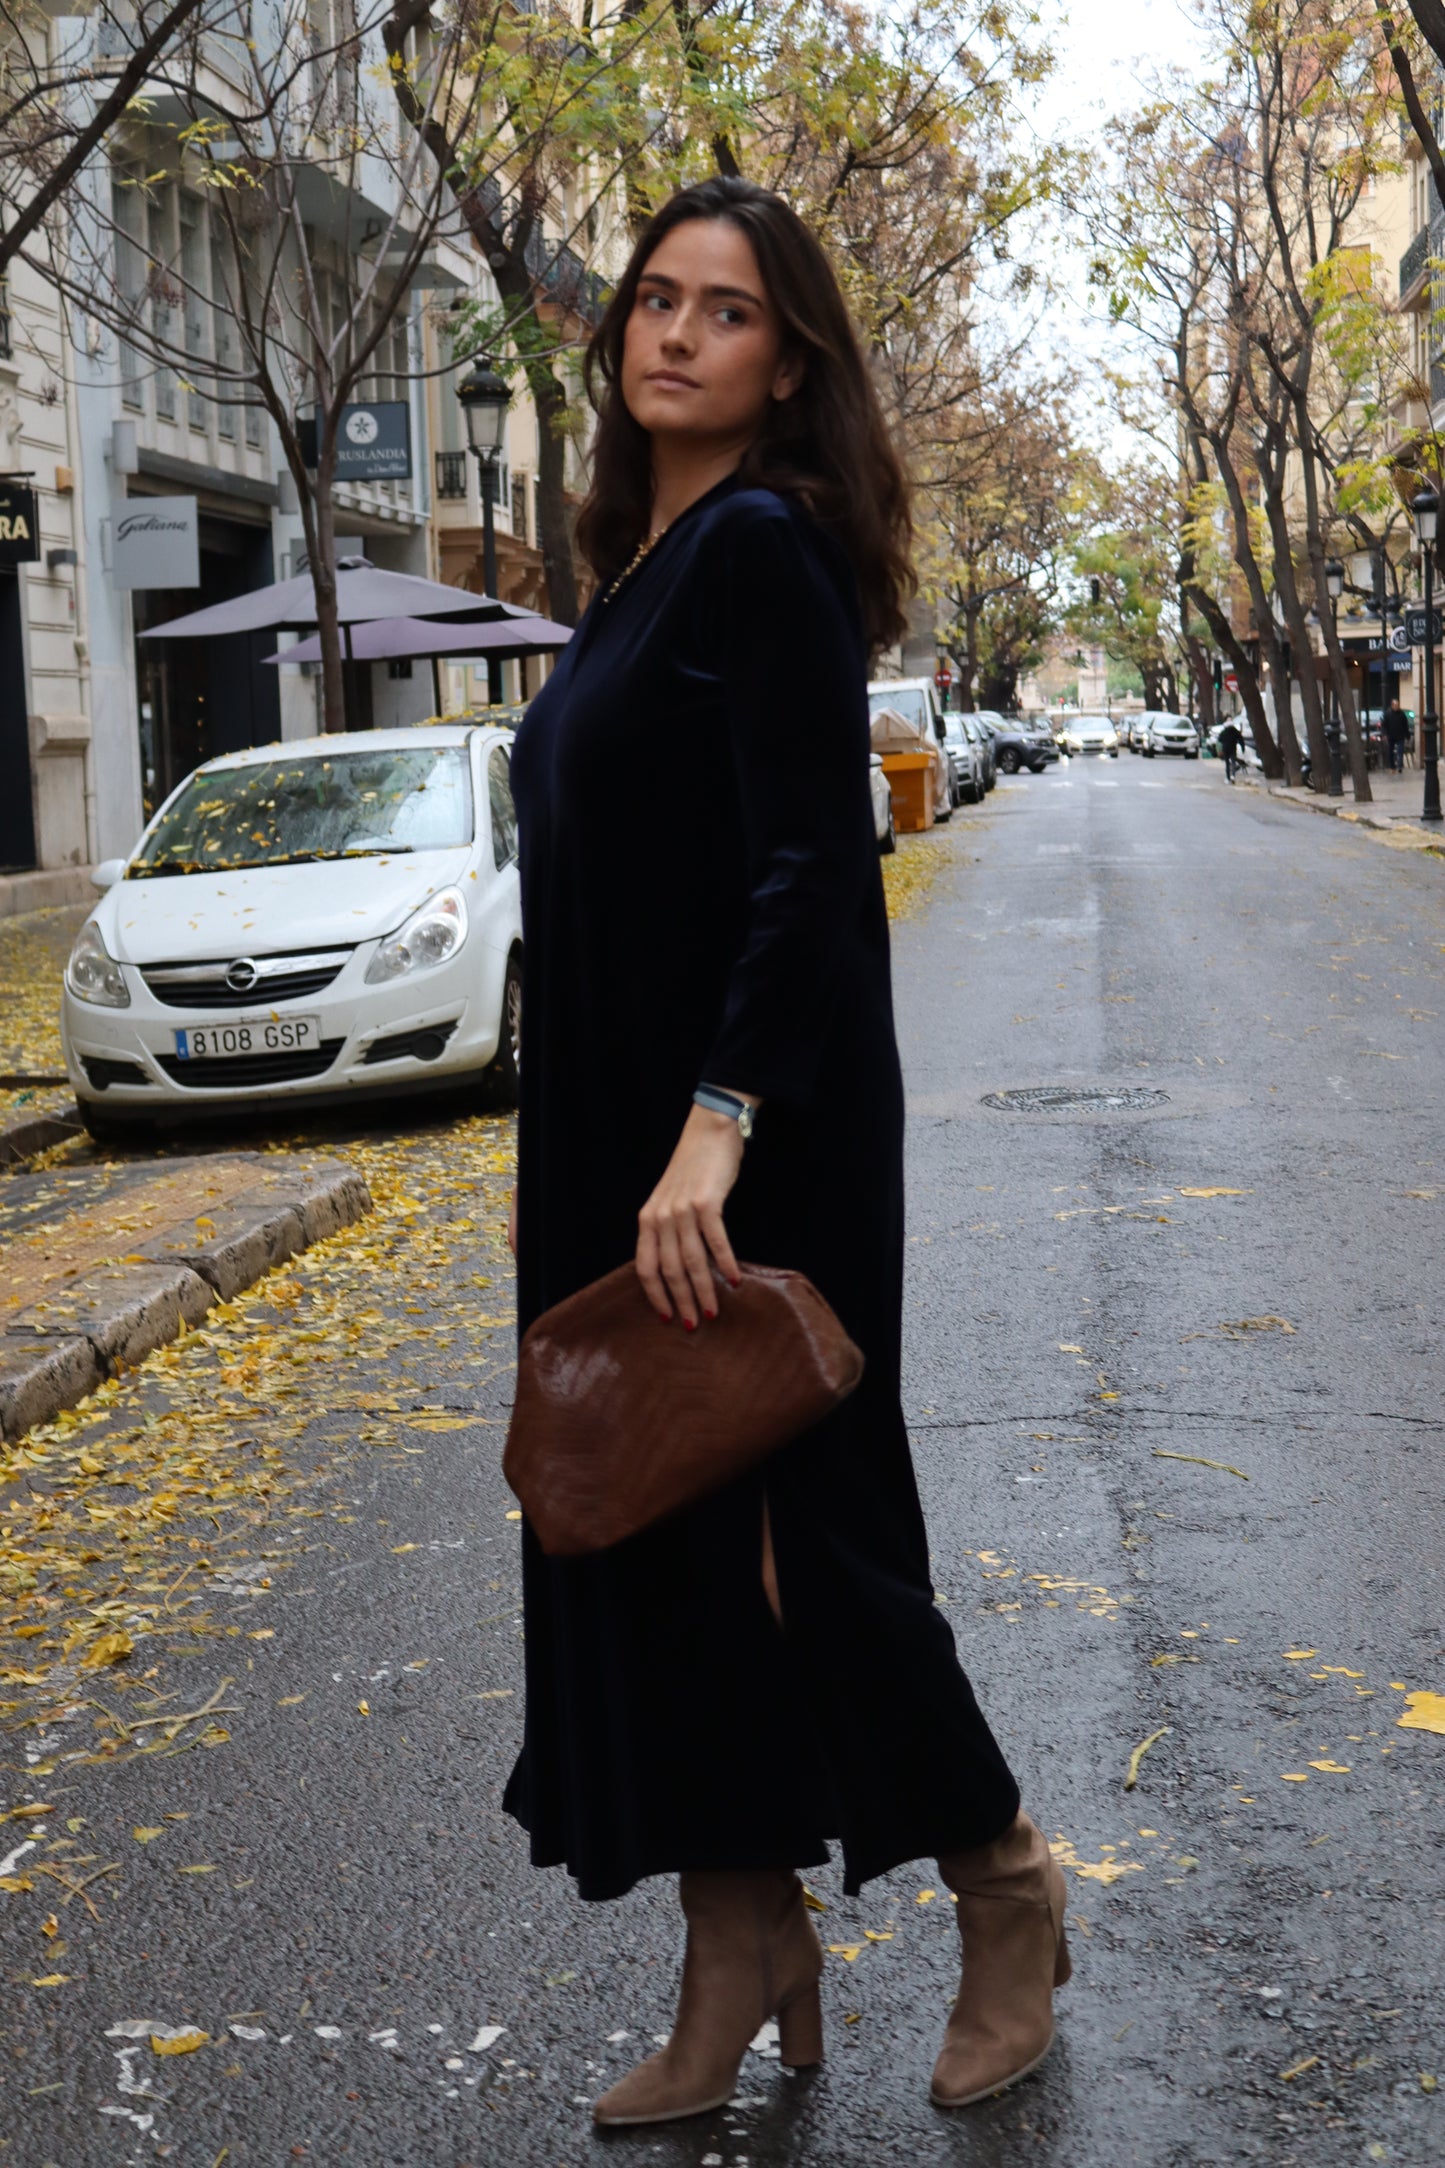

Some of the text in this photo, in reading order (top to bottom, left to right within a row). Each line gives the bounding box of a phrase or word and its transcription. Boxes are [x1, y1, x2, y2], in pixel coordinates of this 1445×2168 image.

[318, 448, 407, 462] RUSLANDIA
[118, 513, 188, 541] Galiana
[1393, 662, 1412, 672] BAR
[193, 1023, 309, 1055] 8108 GSP
